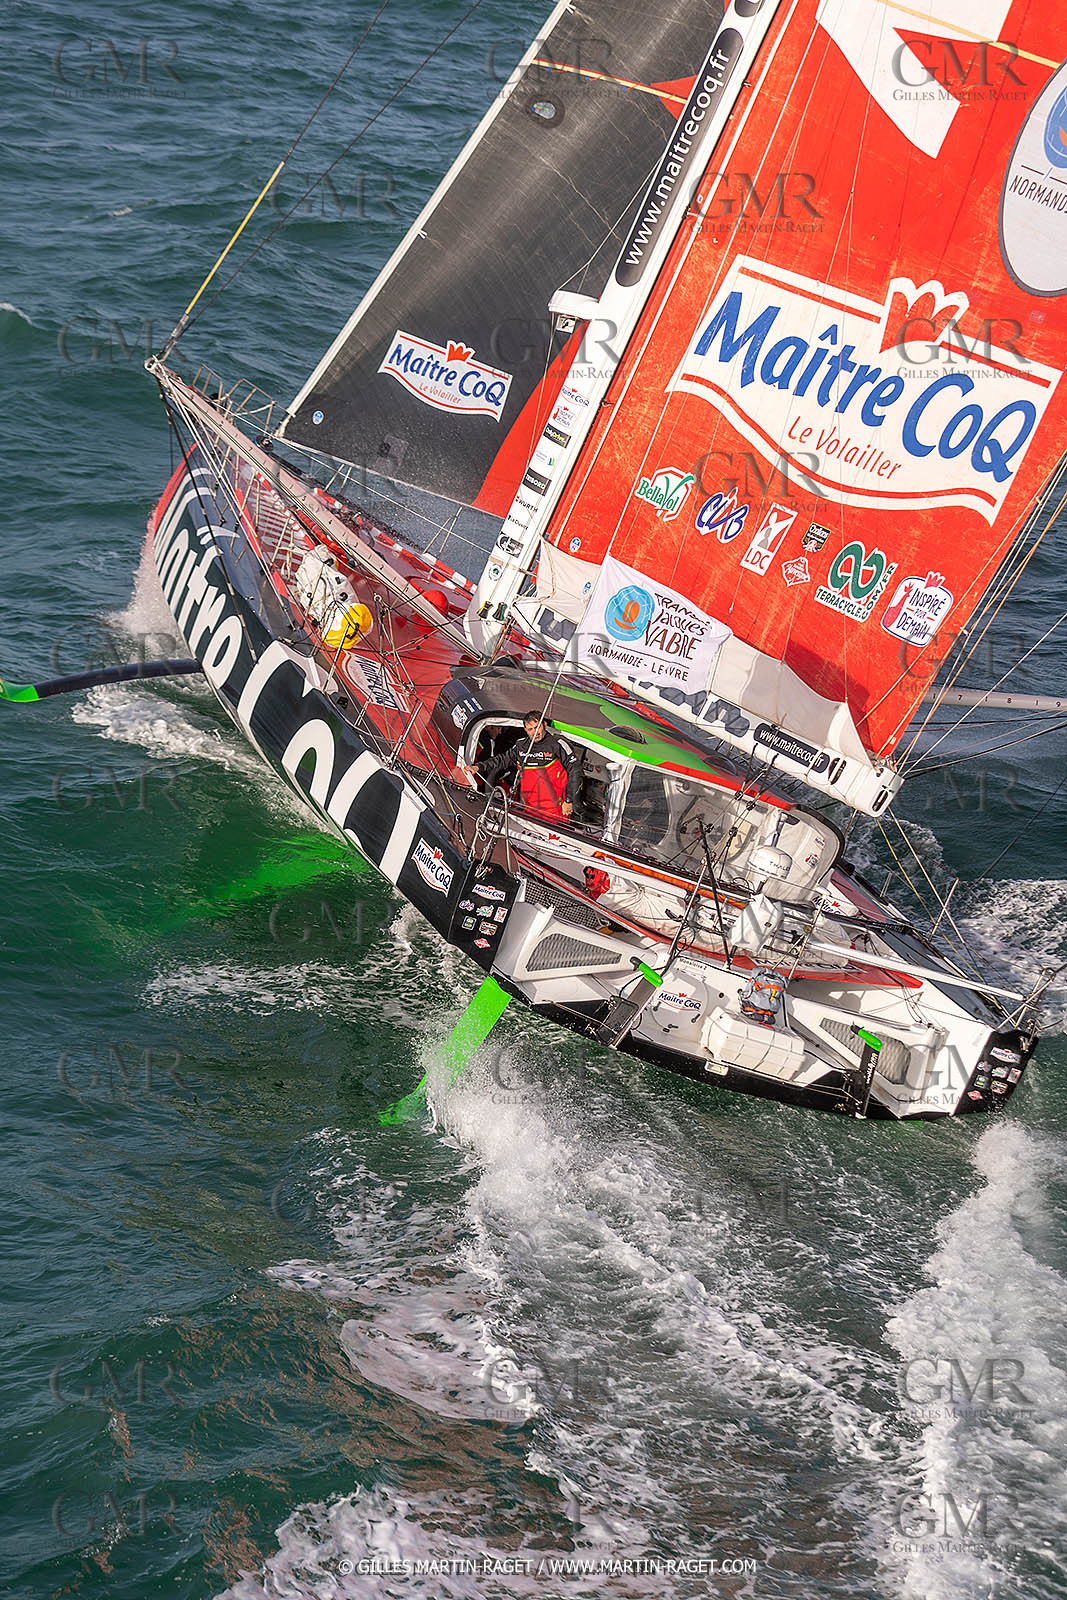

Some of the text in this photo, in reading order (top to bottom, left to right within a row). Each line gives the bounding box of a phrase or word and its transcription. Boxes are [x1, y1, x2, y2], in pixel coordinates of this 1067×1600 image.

[625, 48, 729, 265] www.maitrecoq.fr
[388, 343, 506, 407] Maître CoQ
[694, 291, 1036, 483] Maître CoQ
[788, 416, 903, 480] Le Volailler
[745, 547, 770, 570] LDC
[588, 643, 644, 668] NORMANDIE
[644, 620, 702, 660] VABRE
[759, 728, 825, 768] www.maitrecoqfr
